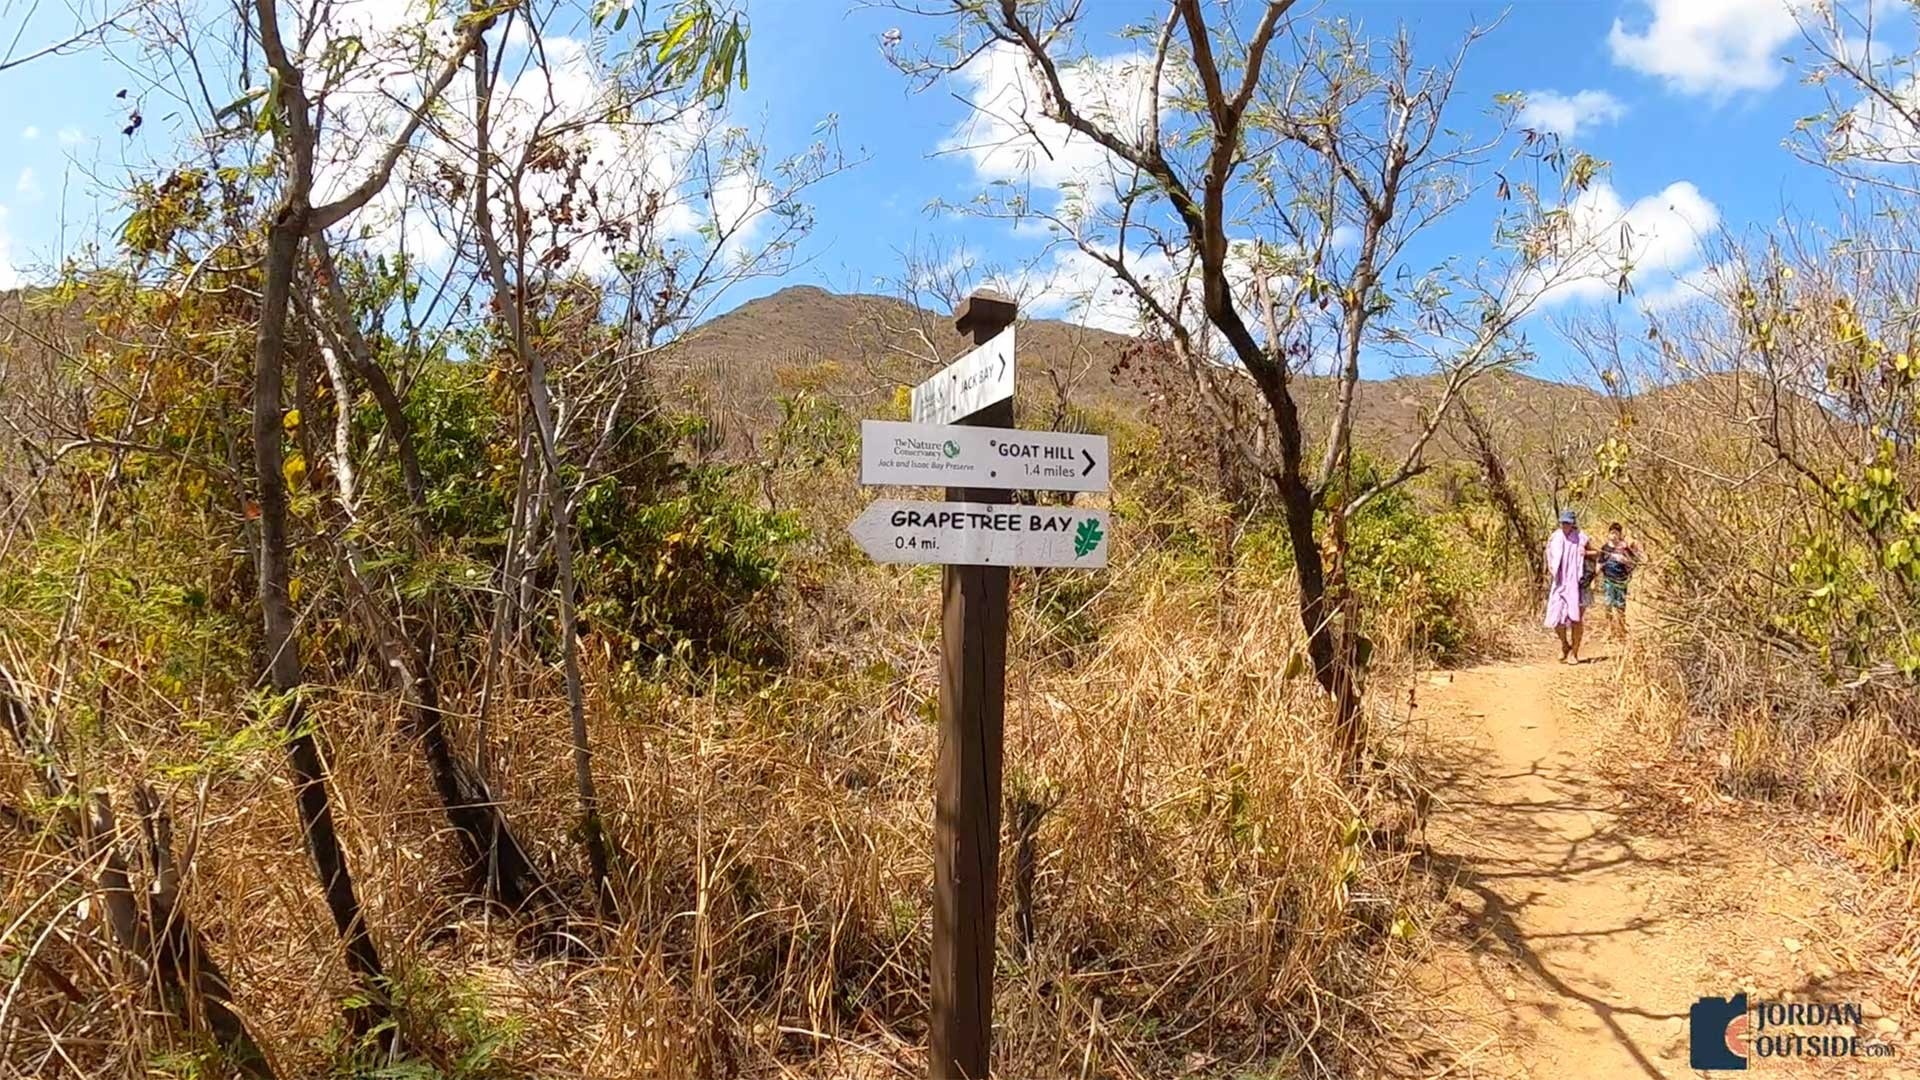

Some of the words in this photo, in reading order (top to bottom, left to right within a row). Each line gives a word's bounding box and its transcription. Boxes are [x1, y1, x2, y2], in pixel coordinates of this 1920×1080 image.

[907, 438, 942, 450] Nature
[893, 448, 942, 459] Conservancy
[998, 443, 1039, 459] GOAT
[1044, 446, 1075, 460] HILL
[878, 459, 894, 468] Jack
[896, 460, 909, 468] and
[911, 460, 928, 469] Isaac
[930, 461, 943, 471] Bay
[945, 463, 975, 471] Preserve
[1024, 463, 1041, 475] 1.4
[1044, 464, 1076, 477] miles
[891, 510, 1022, 532] GRAPETREE
[1029, 516, 1073, 532] BAY
[895, 536, 917, 550] 0.4
[921, 537, 940, 550] mi.
